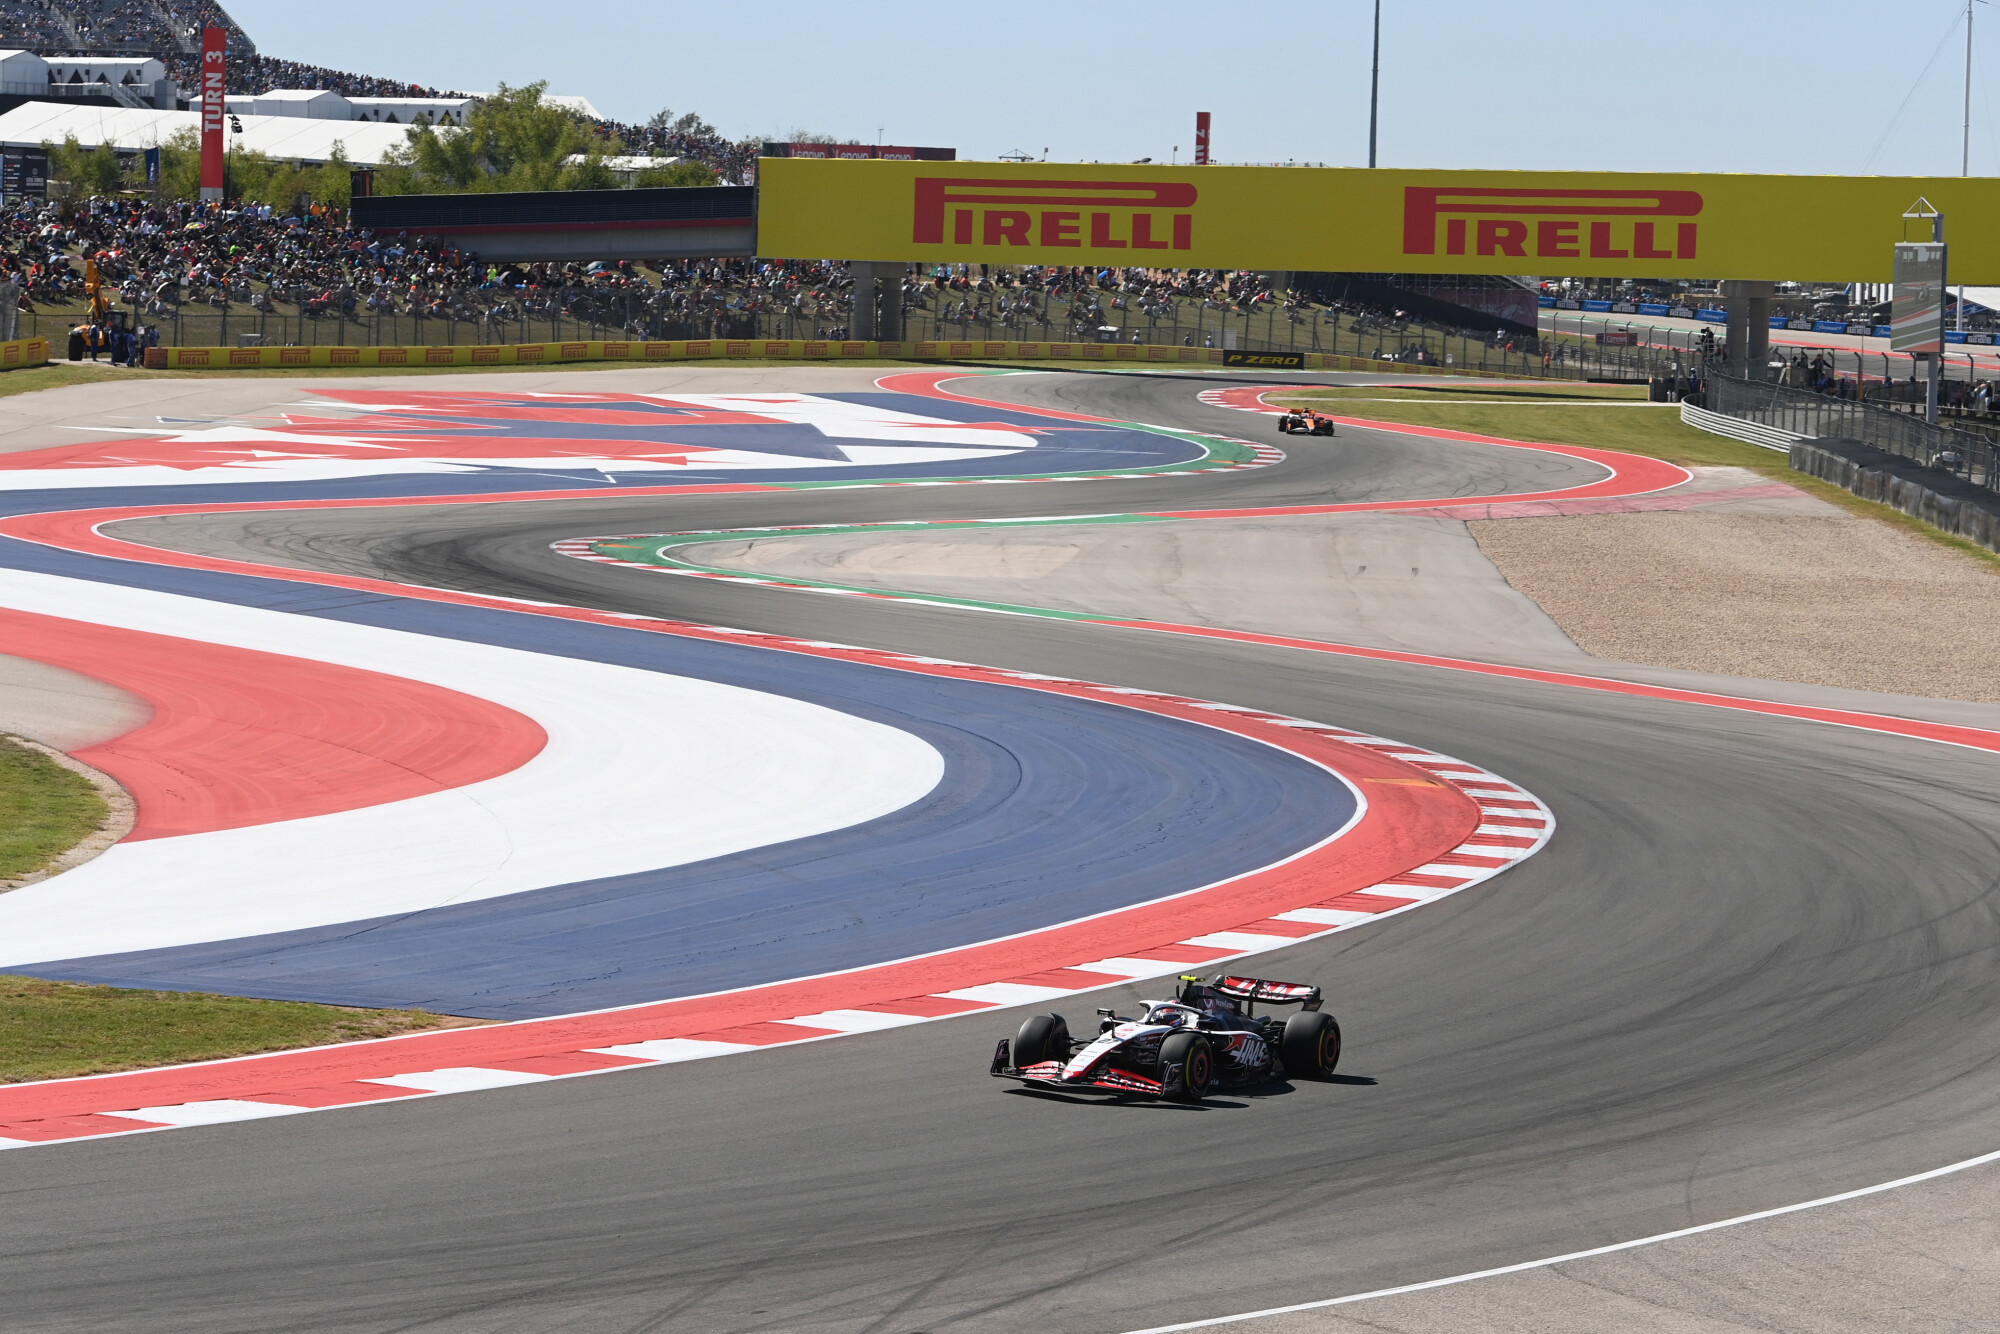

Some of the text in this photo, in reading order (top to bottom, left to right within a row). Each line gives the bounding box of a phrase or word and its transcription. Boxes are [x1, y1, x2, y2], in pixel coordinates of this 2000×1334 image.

[204, 50, 223, 132] TURN 3
[913, 177, 1198, 250] PIRELLI
[1403, 186, 1704, 259] PIRELLI
[472, 348, 500, 362] PIRELLI
[517, 346, 544, 361] PIRELLI
[561, 344, 588, 358] PIRELLI
[604, 344, 629, 357] PIRELLI
[645, 343, 670, 357] PIRELLI
[686, 342, 711, 356] PIRELLI
[726, 342, 751, 355] PIRELLI
[765, 343, 789, 356] PIRELLI
[804, 343, 827, 356] PIRELLI
[842, 343, 865, 356] PIRELLI
[178, 350, 209, 365] PIRELLI
[230, 350, 261, 364] PIRELLI
[280, 349, 311, 363] PIRELLI
[330, 349, 360, 363] PIRELLI
[378, 349, 408, 363] PIRELLI
[425, 349, 454, 363] PIRELLI
[1227, 355, 1242, 363] P
[1243, 355, 1299, 366] ZERO
